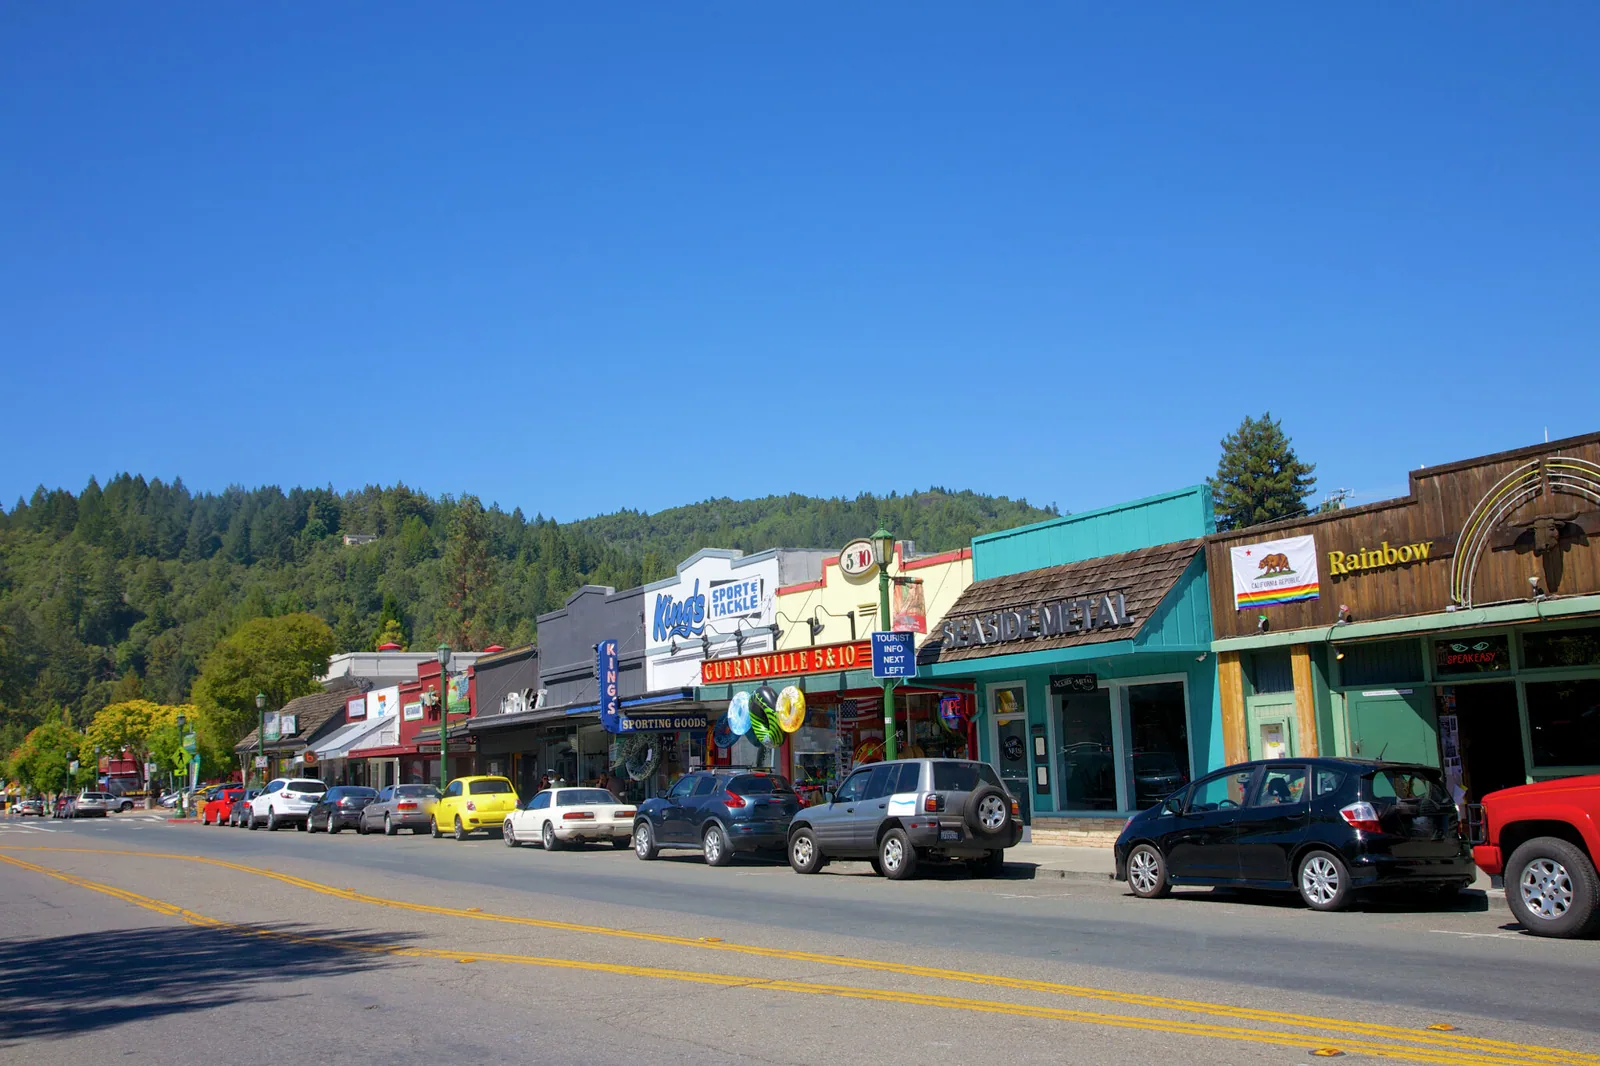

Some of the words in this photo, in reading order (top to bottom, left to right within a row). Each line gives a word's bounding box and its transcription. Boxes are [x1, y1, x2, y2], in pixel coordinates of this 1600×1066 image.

[846, 553, 854, 570] 5
[859, 549, 871, 568] 10
[1328, 541, 1433, 576] Rainbow
[712, 582, 750, 603] SPORT
[1251, 579, 1278, 589] CALIFORNIA
[1278, 576, 1301, 586] REPUBLIC
[653, 578, 706, 642] King's
[712, 595, 758, 617] TACKLE
[941, 608, 1037, 649] SEASIDE
[1038, 594, 1135, 637] METAL
[876, 633, 910, 643] TOURIST
[883, 655, 905, 664] NEXT
[884, 645, 903, 653] INFO
[1447, 652, 1496, 665] SPEAKEASY
[704, 650, 809, 681] GUERNEVILLE
[884, 665, 905, 675] LEFT
[605, 643, 617, 715] KING'S
[622, 719, 672, 730] SPORTING
[674, 717, 707, 728] GOODS
